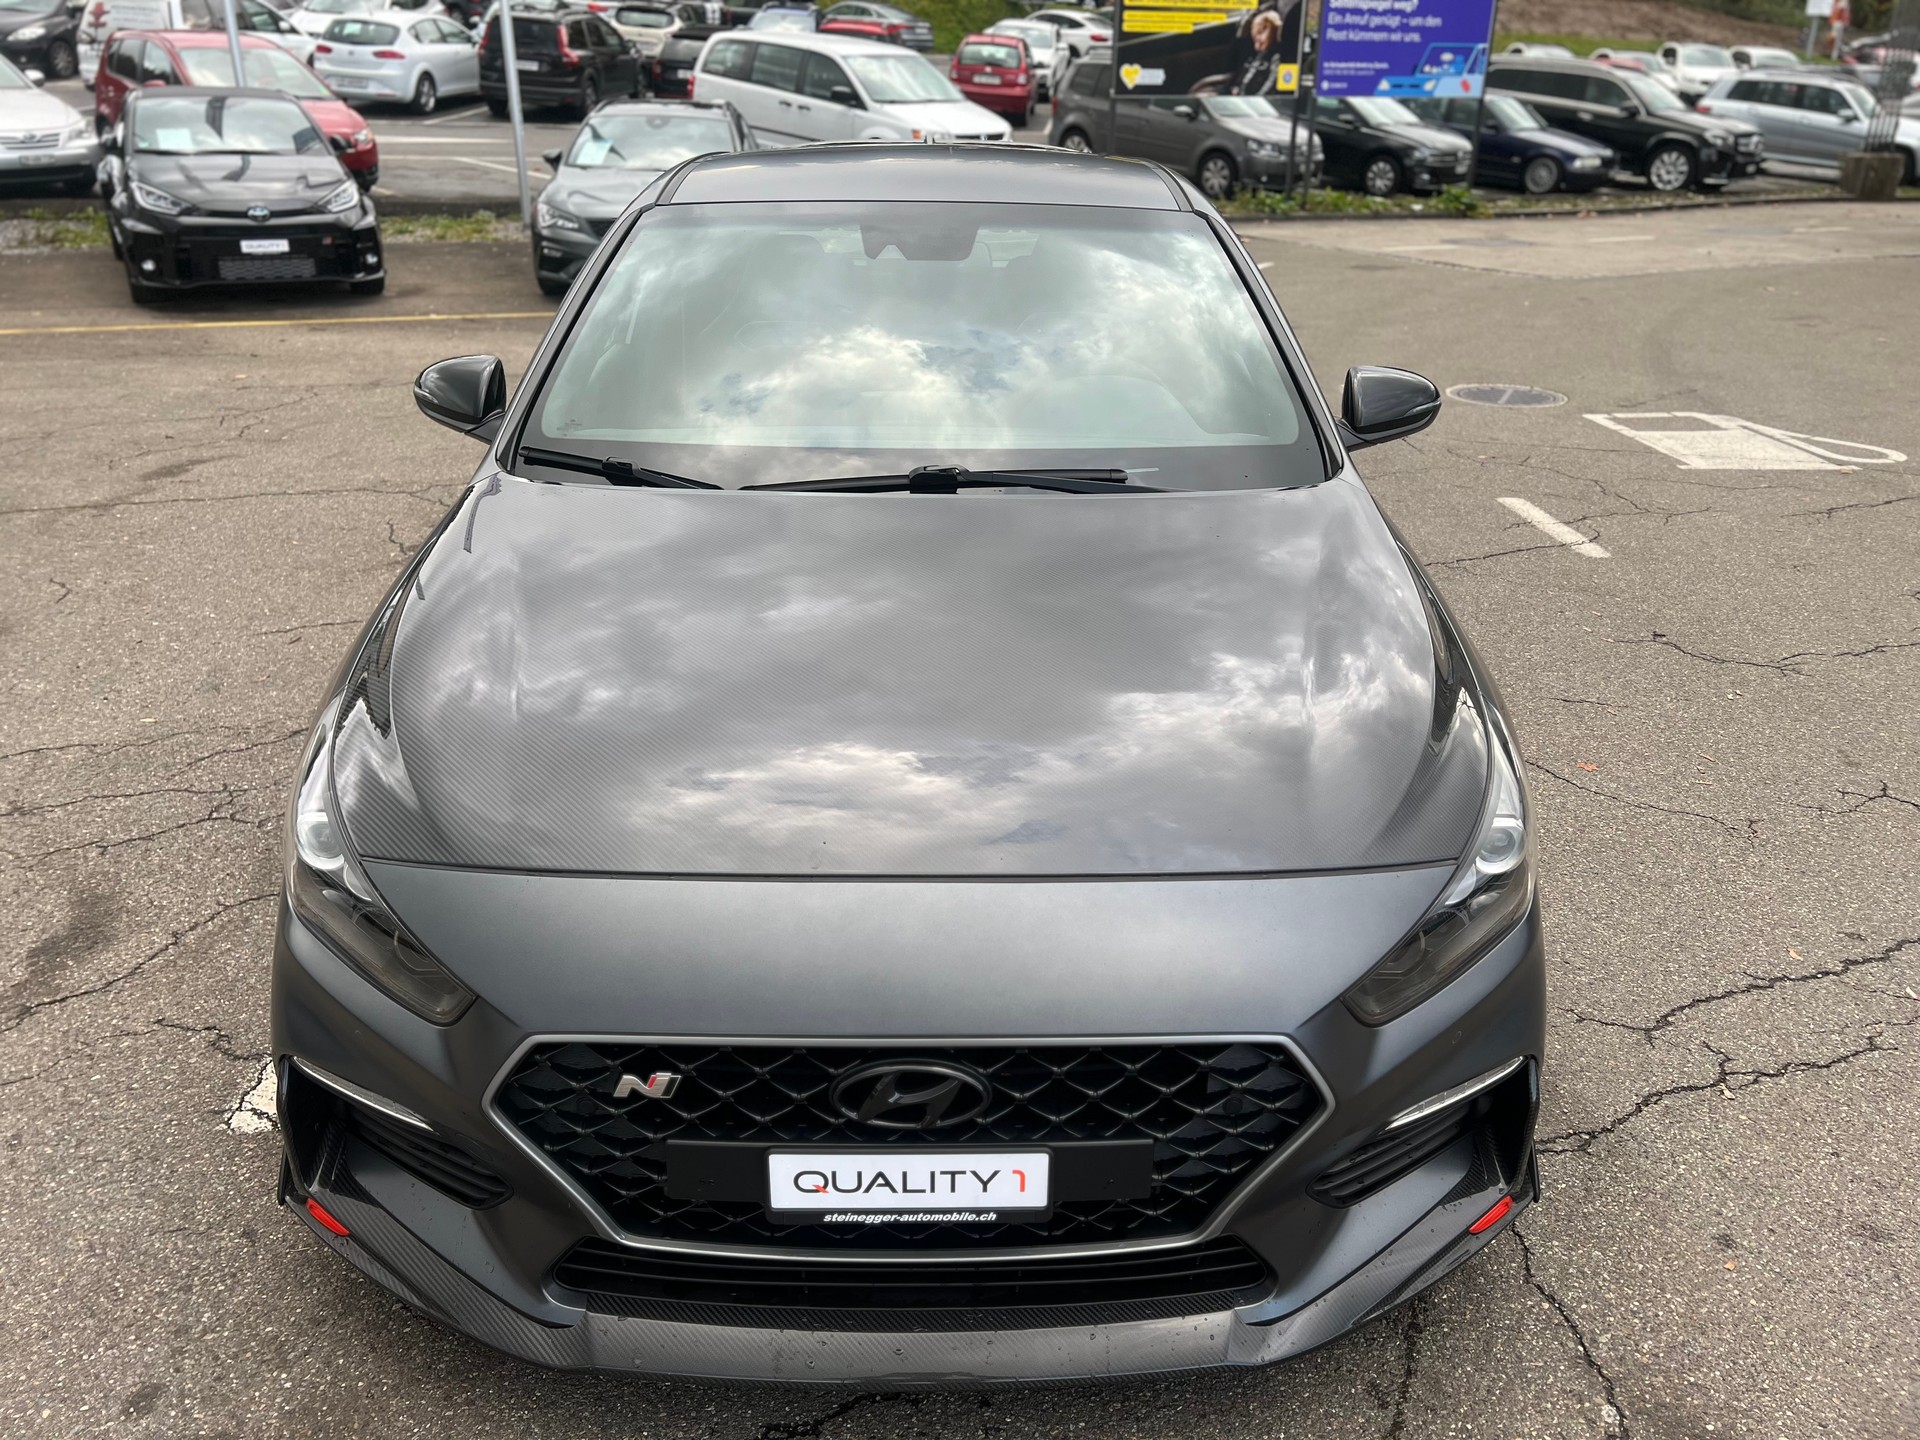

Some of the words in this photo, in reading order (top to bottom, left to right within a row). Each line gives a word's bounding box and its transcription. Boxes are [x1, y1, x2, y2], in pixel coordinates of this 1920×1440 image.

[1328, 11, 1343, 25] Ein
[1344, 12, 1369, 26] Anruf
[1369, 13, 1400, 29] genügt
[1409, 16, 1424, 26] um
[1425, 14, 1442, 27] den
[1326, 28, 1348, 41] Rest
[1349, 29, 1388, 42] kümmern
[1390, 30, 1402, 42] wir
[1403, 32, 1422, 43] uns.
[793, 1170, 1001, 1194] QUALITY
[1012, 1169, 1026, 1193] 1
[823, 1211, 997, 1223] steinegger-automobile.ch
